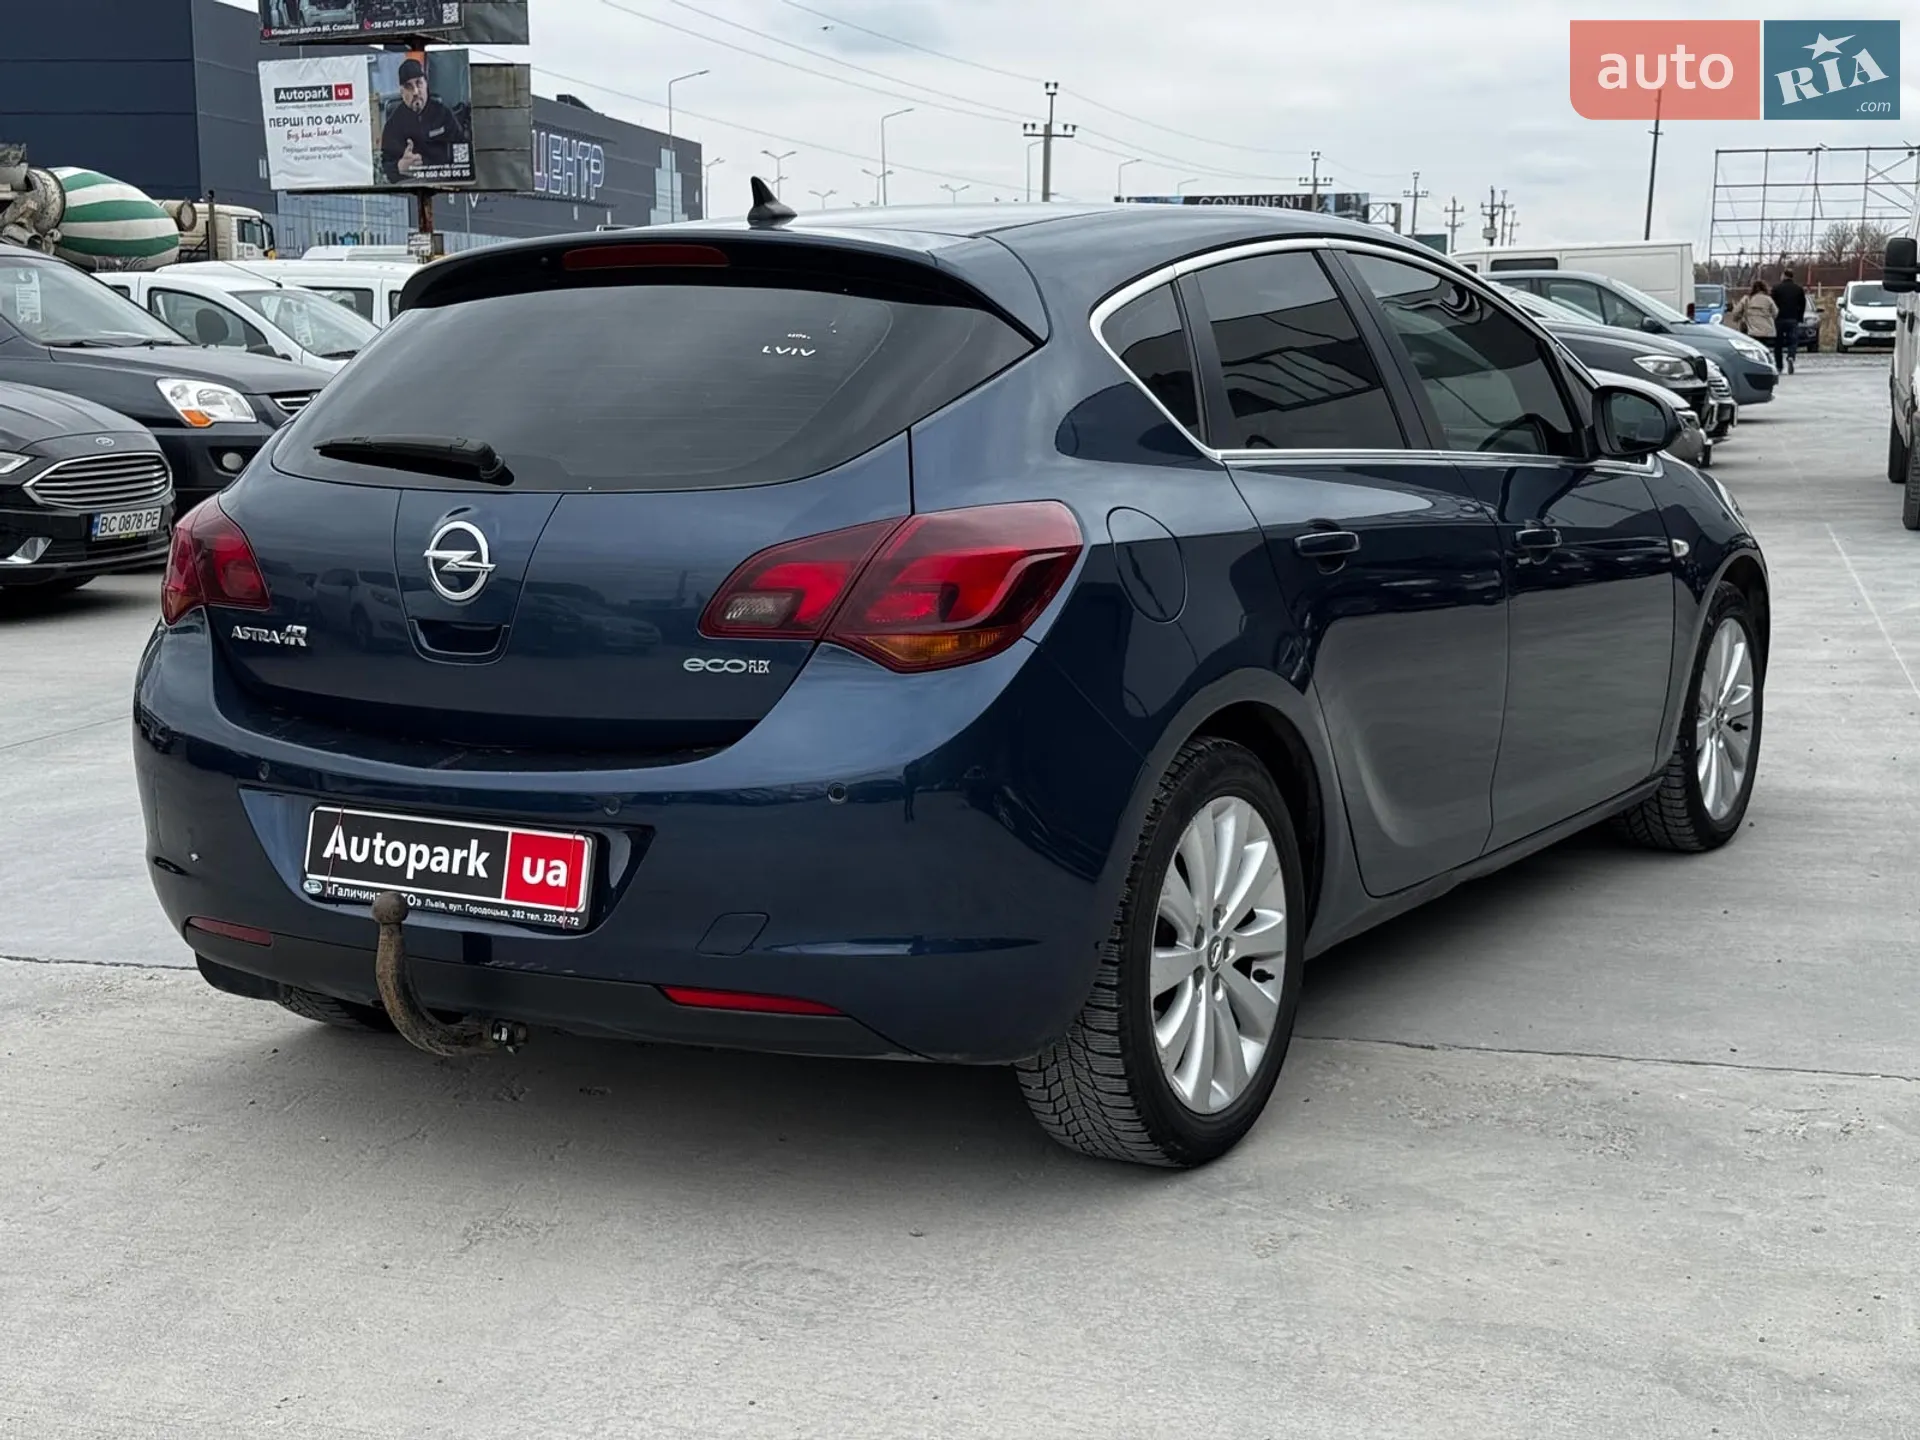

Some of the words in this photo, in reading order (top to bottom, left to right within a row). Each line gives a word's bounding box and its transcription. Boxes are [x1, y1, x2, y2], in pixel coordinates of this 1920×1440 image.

[278, 86, 329, 101] Autopark
[338, 87, 350, 97] ua
[268, 116, 304, 128] ПЕРШІ
[307, 115, 323, 126] ПО
[325, 113, 363, 125] ФАКТУ.
[1198, 194, 1307, 208] CONTINENT
[761, 345, 817, 357] LVIV
[100, 516, 117, 534] BC
[118, 513, 143, 532] 0878
[145, 511, 160, 528] PE
[231, 625, 280, 645] ASTRA
[322, 824, 491, 880] Autopark
[521, 856, 568, 888] ua
[326, 884, 380, 901] «Галичин
[511, 909, 526, 919] 282
